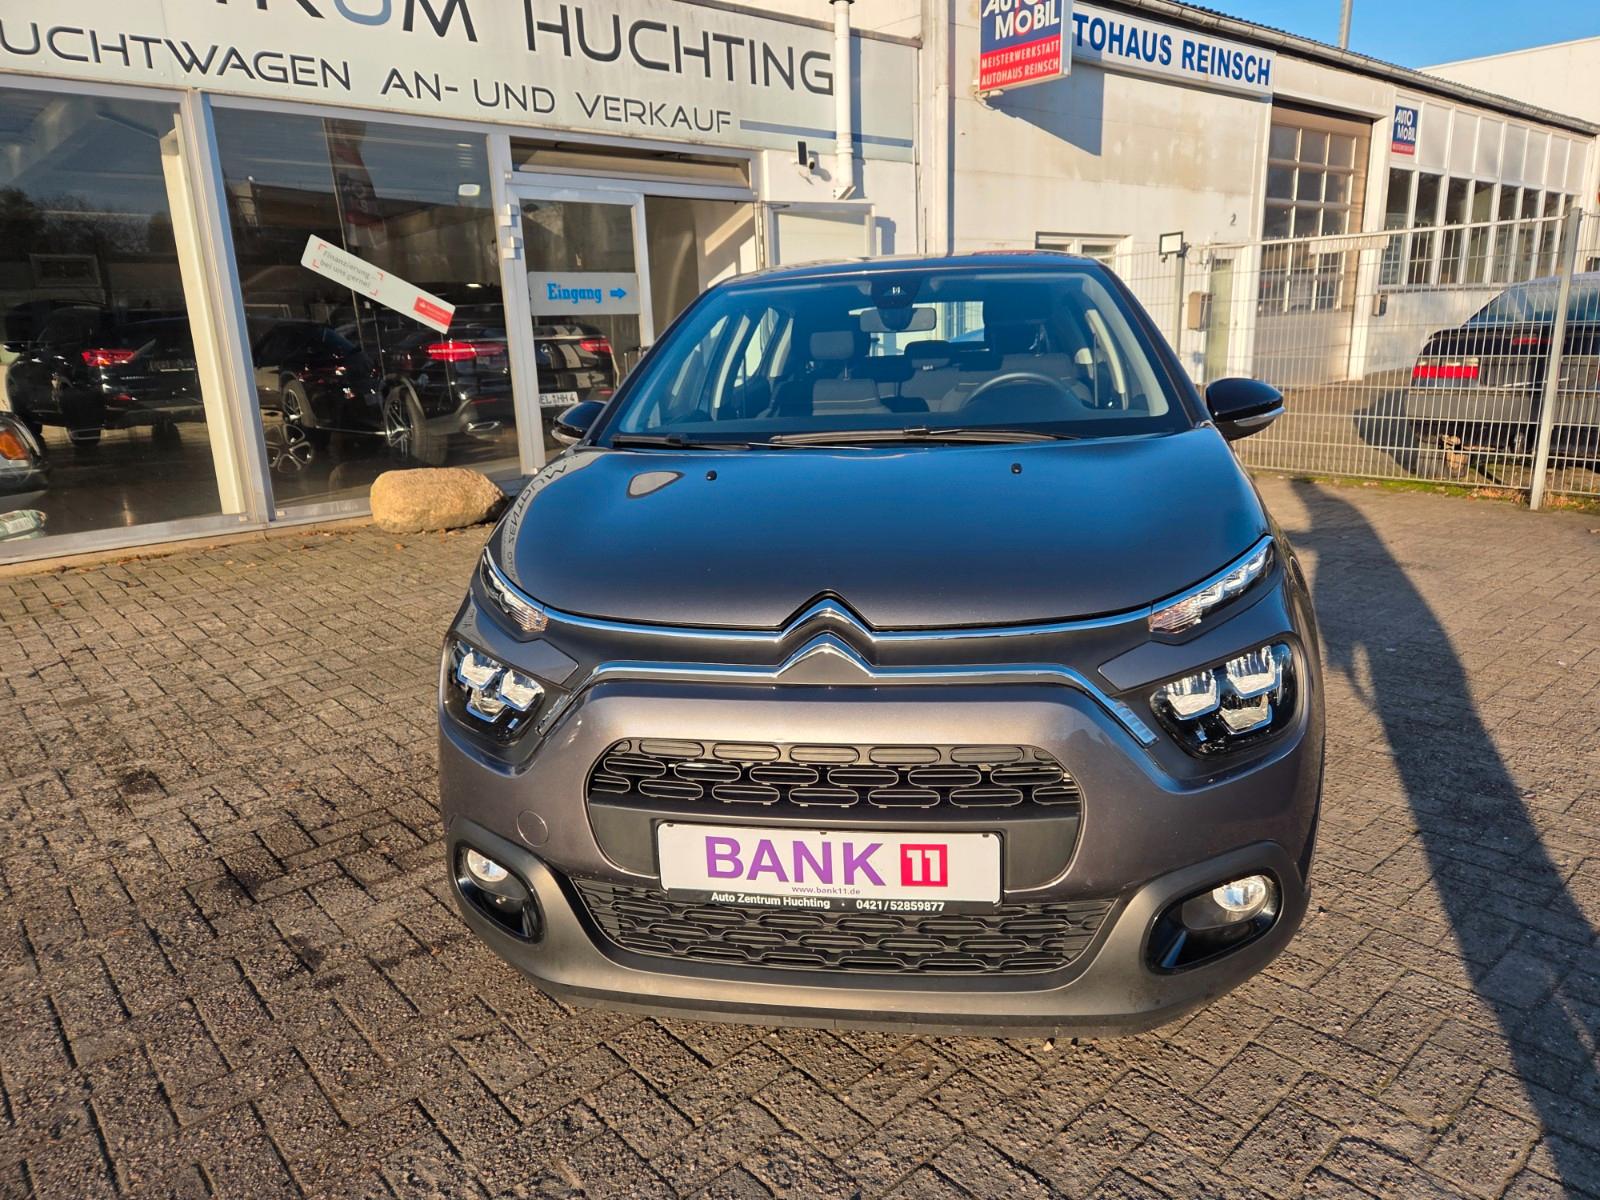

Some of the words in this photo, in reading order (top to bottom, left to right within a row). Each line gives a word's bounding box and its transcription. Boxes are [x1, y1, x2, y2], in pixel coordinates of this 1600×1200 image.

[995, 0, 1060, 41] MOBIL
[524, 0, 834, 96] HUCHTING
[981, 40, 1060, 70] MEISTERWERKSTATT
[1181, 39, 1271, 86] REINSCH
[981, 66, 1023, 87] AUTOHAUS
[1024, 57, 1060, 77] REINSCH
[380, 67, 459, 102] AN-
[473, 78, 556, 114] UND
[576, 92, 732, 133] VERKAUF
[547, 283, 603, 304] Eingang
[705, 836, 887, 887] BANK
[906, 850, 941, 882] 11
[711, 892, 736, 903] Auto
[737, 893, 782, 906] Zentrum
[783, 896, 831, 910] Huchting
[791, 886, 861, 896] www.bank11.de
